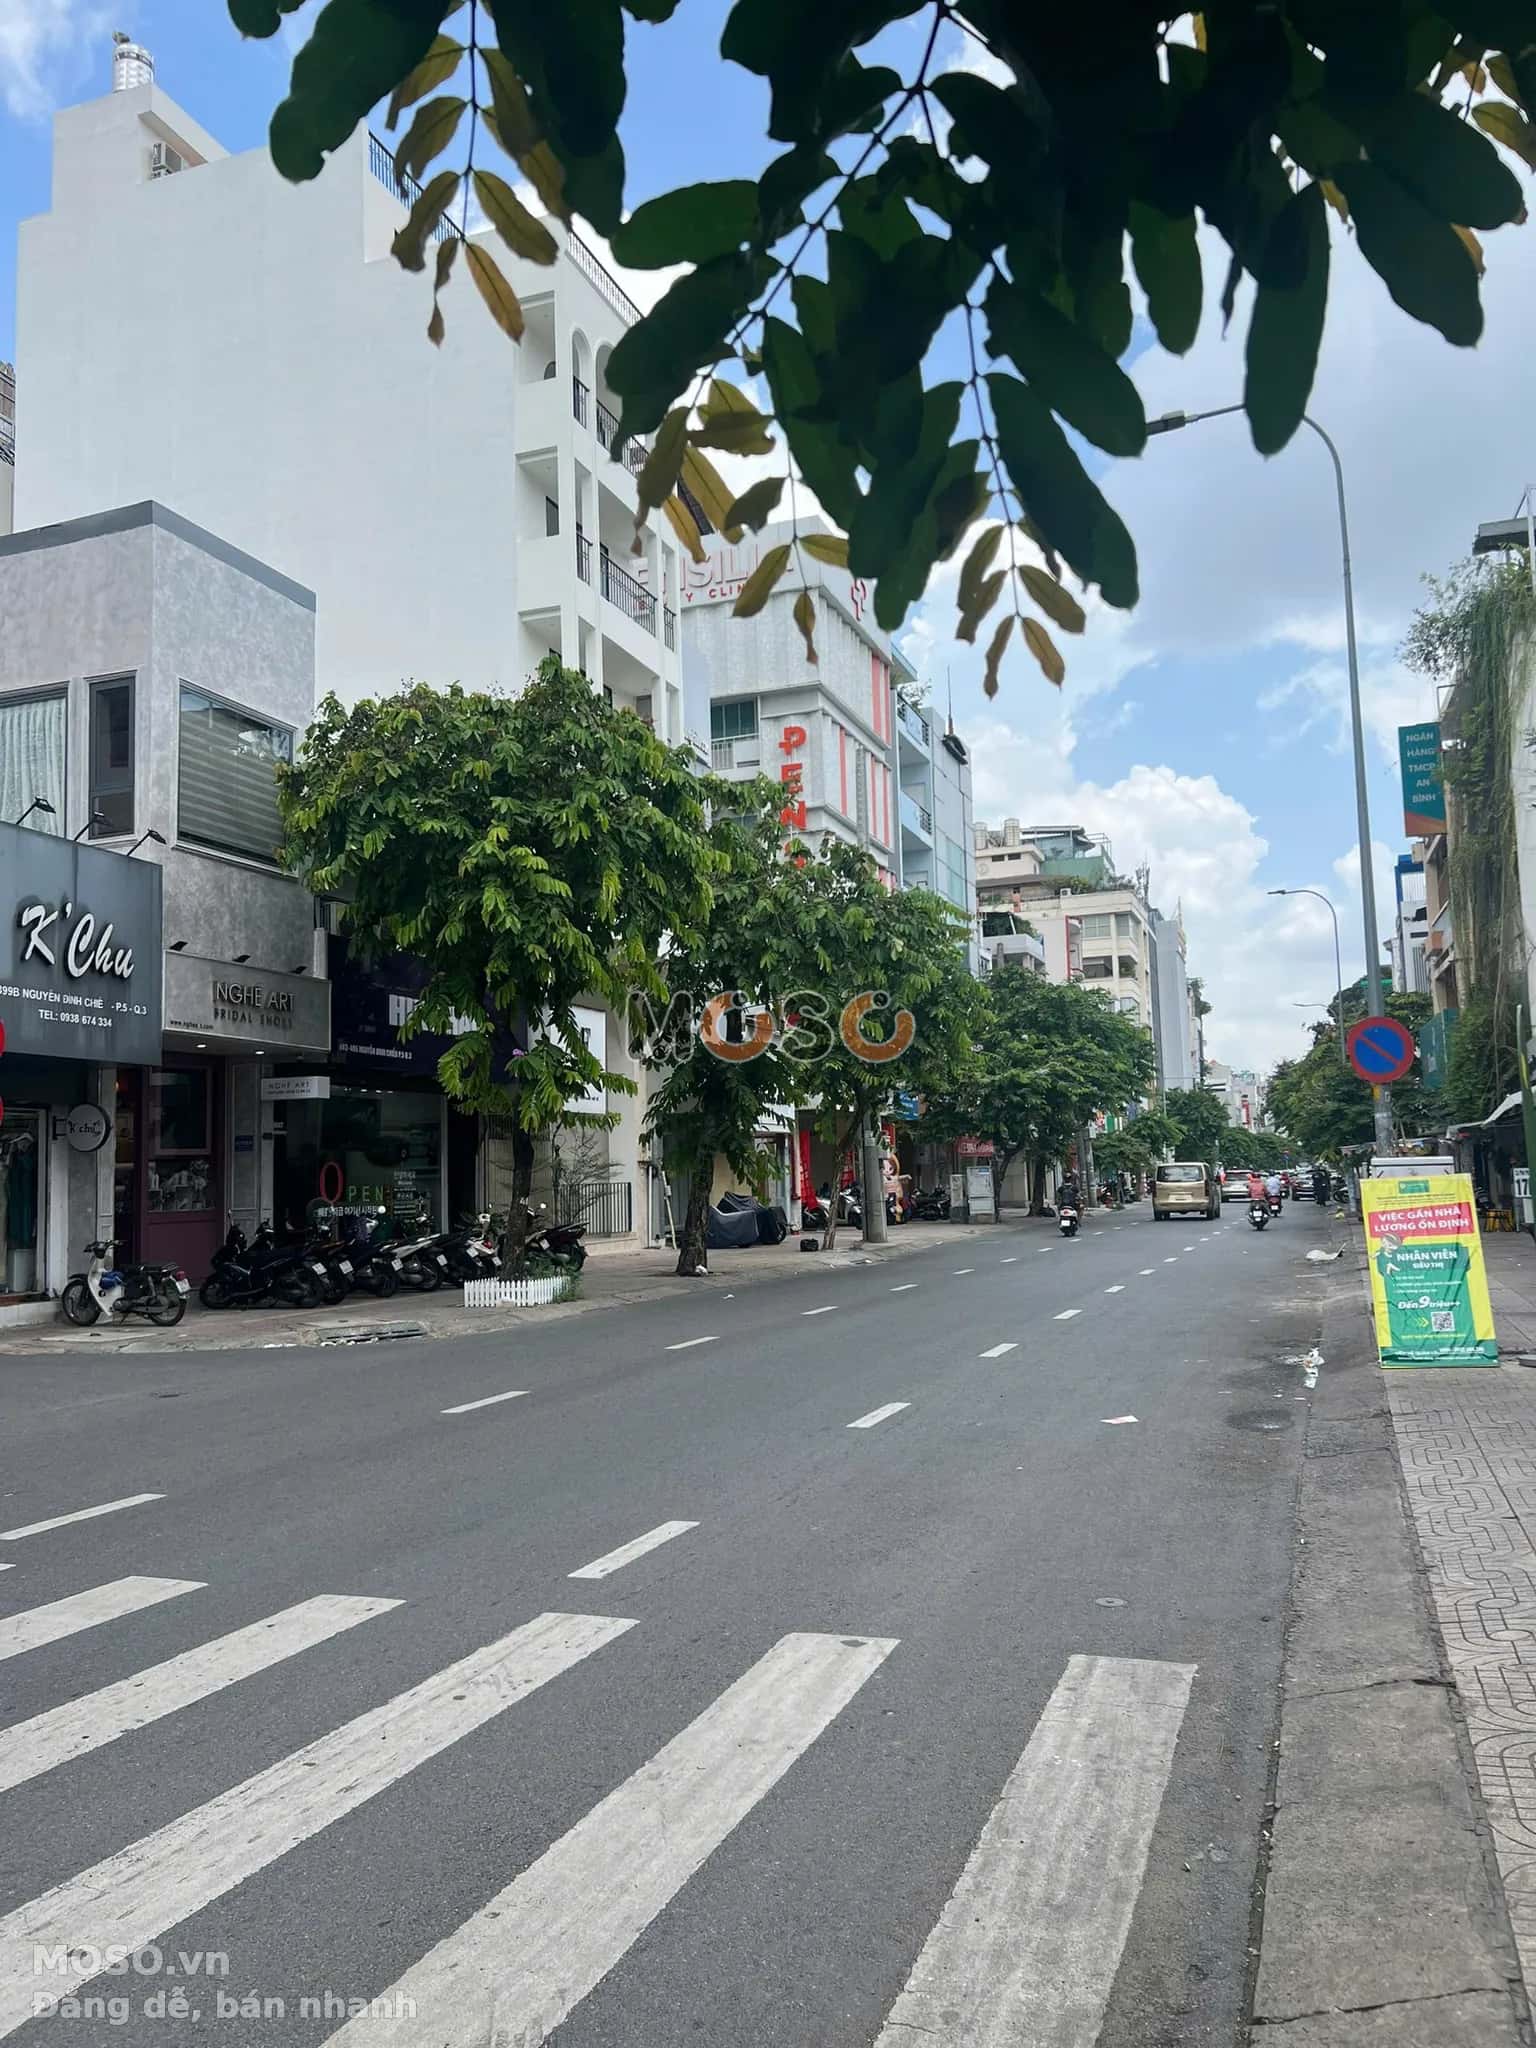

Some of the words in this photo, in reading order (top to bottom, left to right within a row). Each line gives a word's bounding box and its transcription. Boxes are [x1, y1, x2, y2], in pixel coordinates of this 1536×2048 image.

[1416, 779, 1431, 788] AN
[22, 902, 135, 979] K'Chu
[214, 981, 264, 1007] NGHE
[267, 992, 295, 1012] ART
[38, 1008, 58, 1021] TEL:
[214, 1008, 252, 1024] BRIDAL
[1516, 1179, 1528, 1196] 17
[1378, 1211, 1406, 1223] VIỆC
[1396, 1250, 1430, 1261] NHÂN
